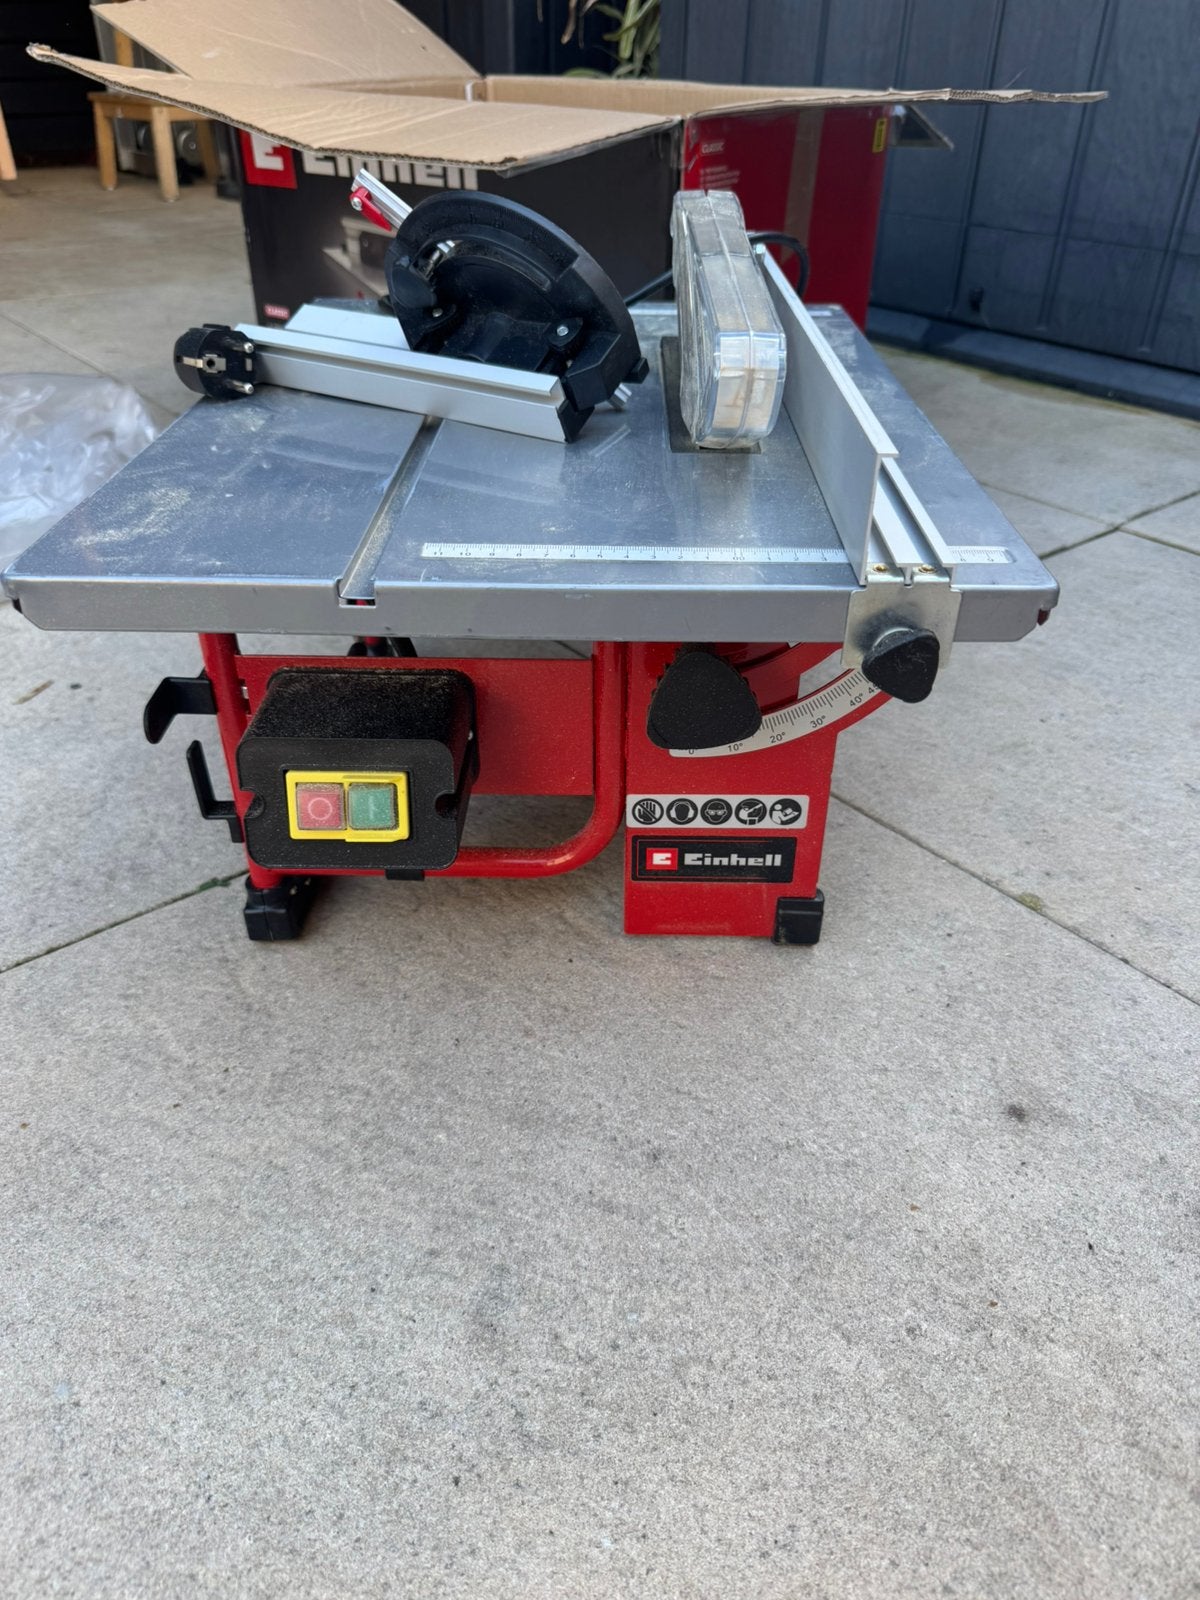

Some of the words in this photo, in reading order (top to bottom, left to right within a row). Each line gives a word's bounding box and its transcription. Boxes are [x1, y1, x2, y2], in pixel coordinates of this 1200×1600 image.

[727, 742, 744, 752] 10°
[769, 731, 787, 744] 20°
[810, 714, 827, 729] 30°
[849, 692, 864, 707] 40°
[683, 852, 783, 867] Einhell
